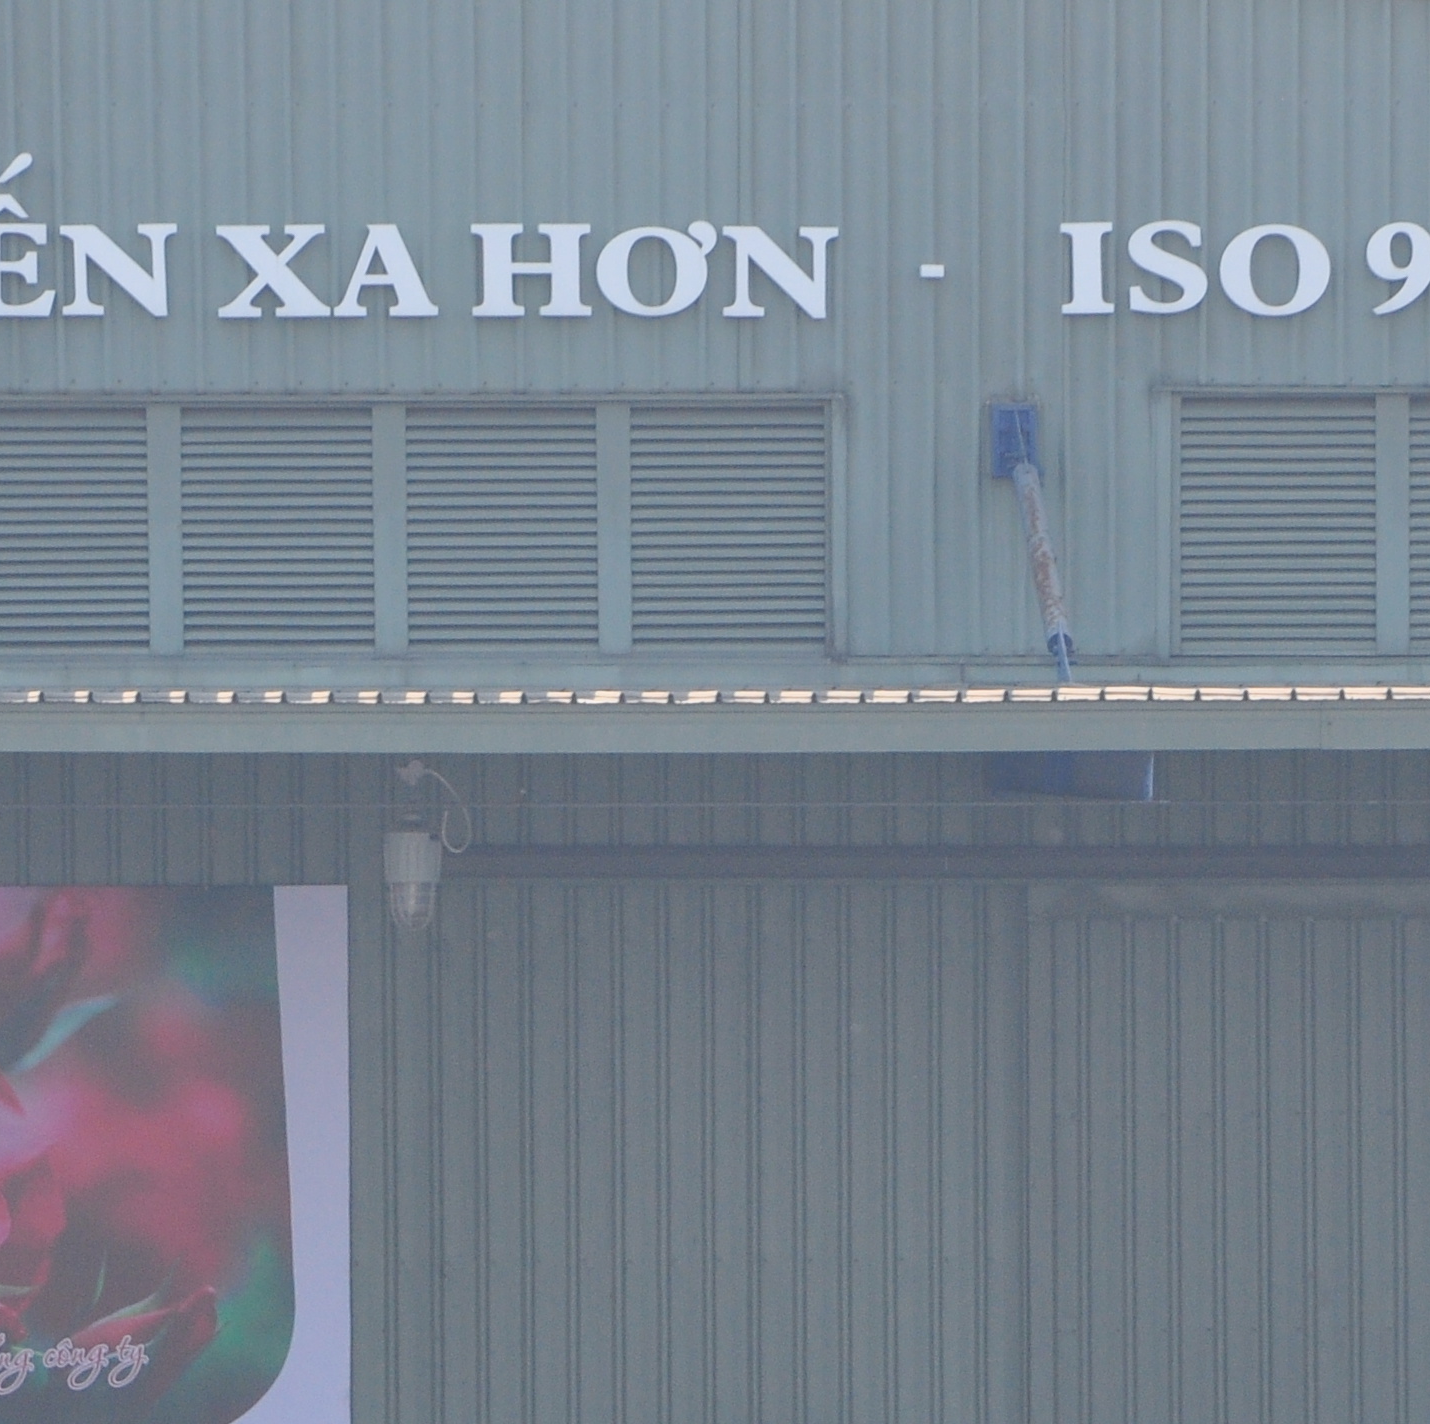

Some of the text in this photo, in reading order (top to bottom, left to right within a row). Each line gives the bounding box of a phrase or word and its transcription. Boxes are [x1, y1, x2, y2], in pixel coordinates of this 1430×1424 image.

[216, 222, 439, 319] XA
[470, 219, 839, 320] HƠN
[1058, 219, 1332, 317] ISO
[42, 1337, 110, 1391] công
[107, 1335, 150, 1388] ty
